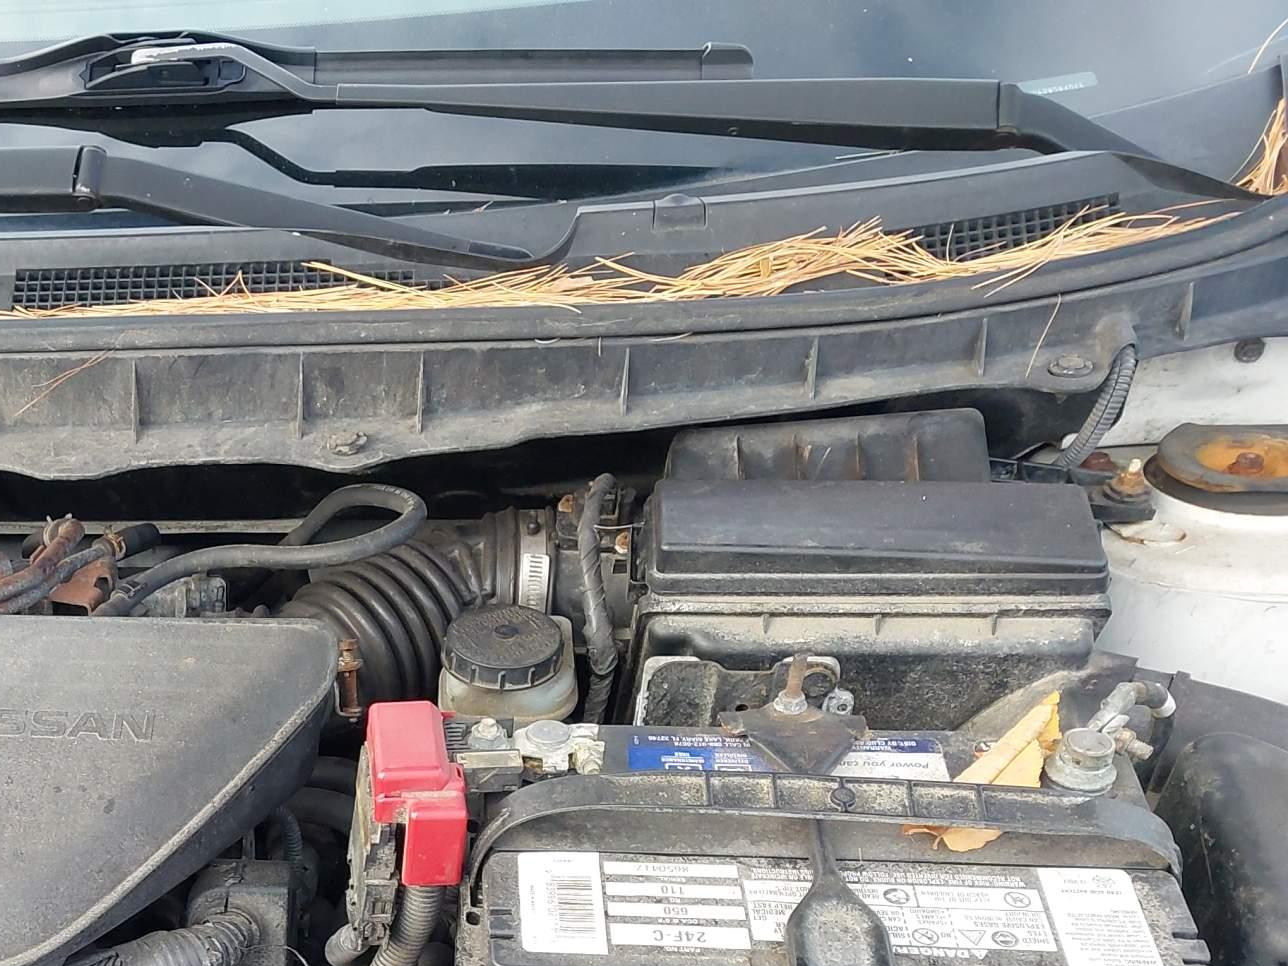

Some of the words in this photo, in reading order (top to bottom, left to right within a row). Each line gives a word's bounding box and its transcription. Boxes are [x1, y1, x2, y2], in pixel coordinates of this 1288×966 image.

[863, 759, 887, 768] you
[660, 885, 683, 895] 110
[663, 906, 689, 916] 650
[652, 930, 707, 943] 24F-C
